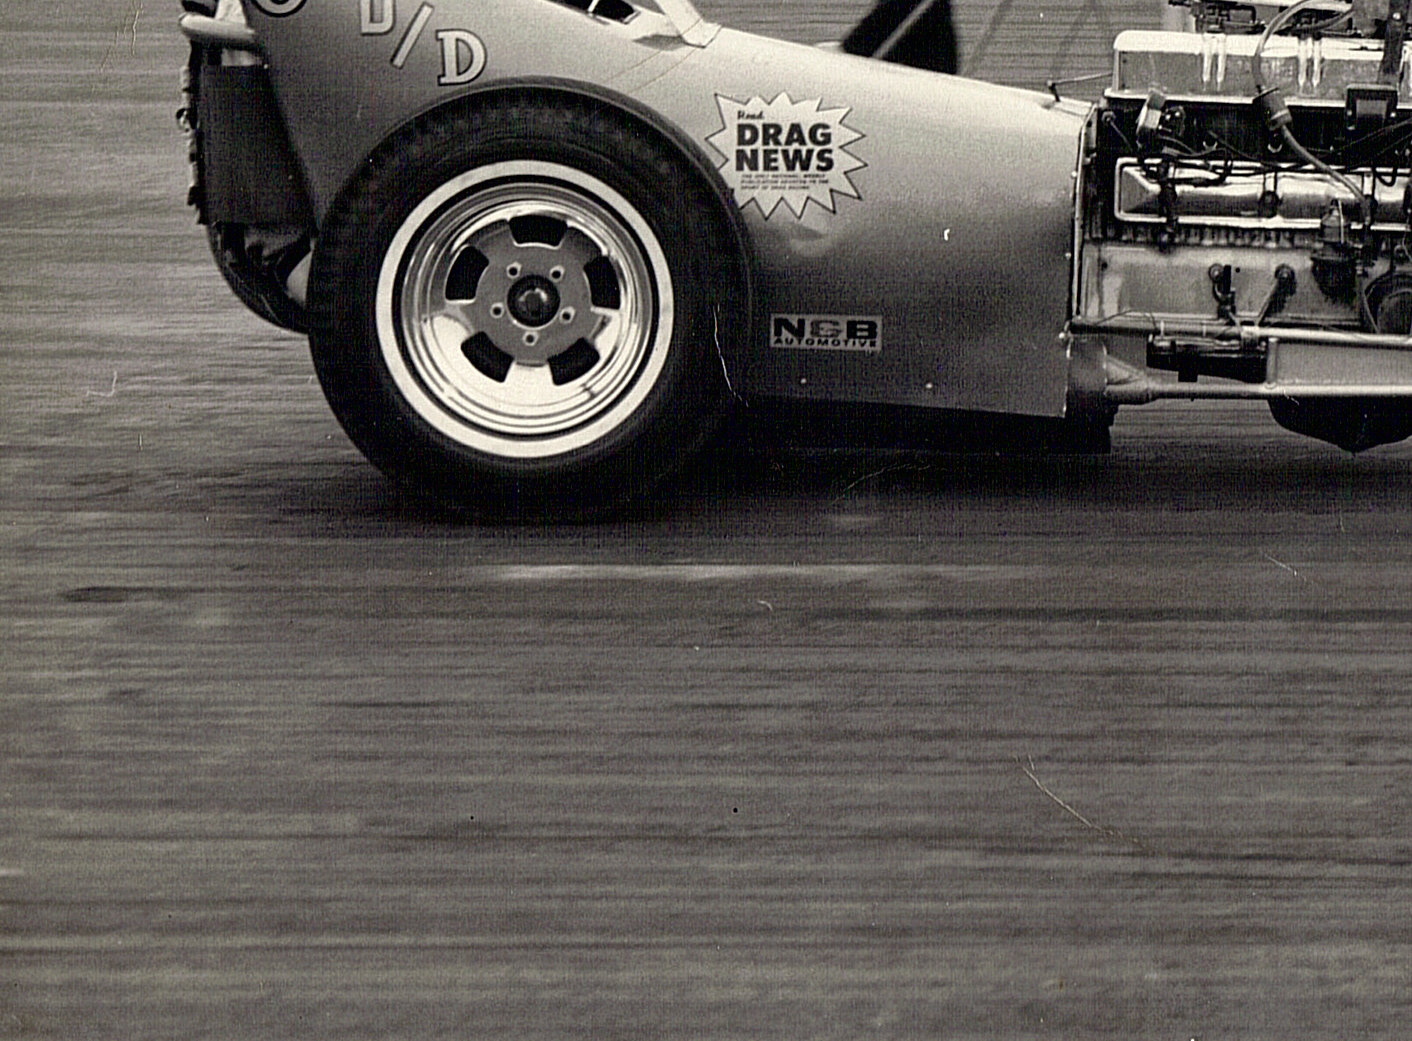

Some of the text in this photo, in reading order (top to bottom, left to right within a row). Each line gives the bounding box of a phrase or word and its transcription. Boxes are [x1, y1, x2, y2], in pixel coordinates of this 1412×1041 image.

[737, 122, 832, 147] DRAG
[735, 148, 835, 172] NEWS
[773, 337, 877, 348] AUTOMOTIVE
